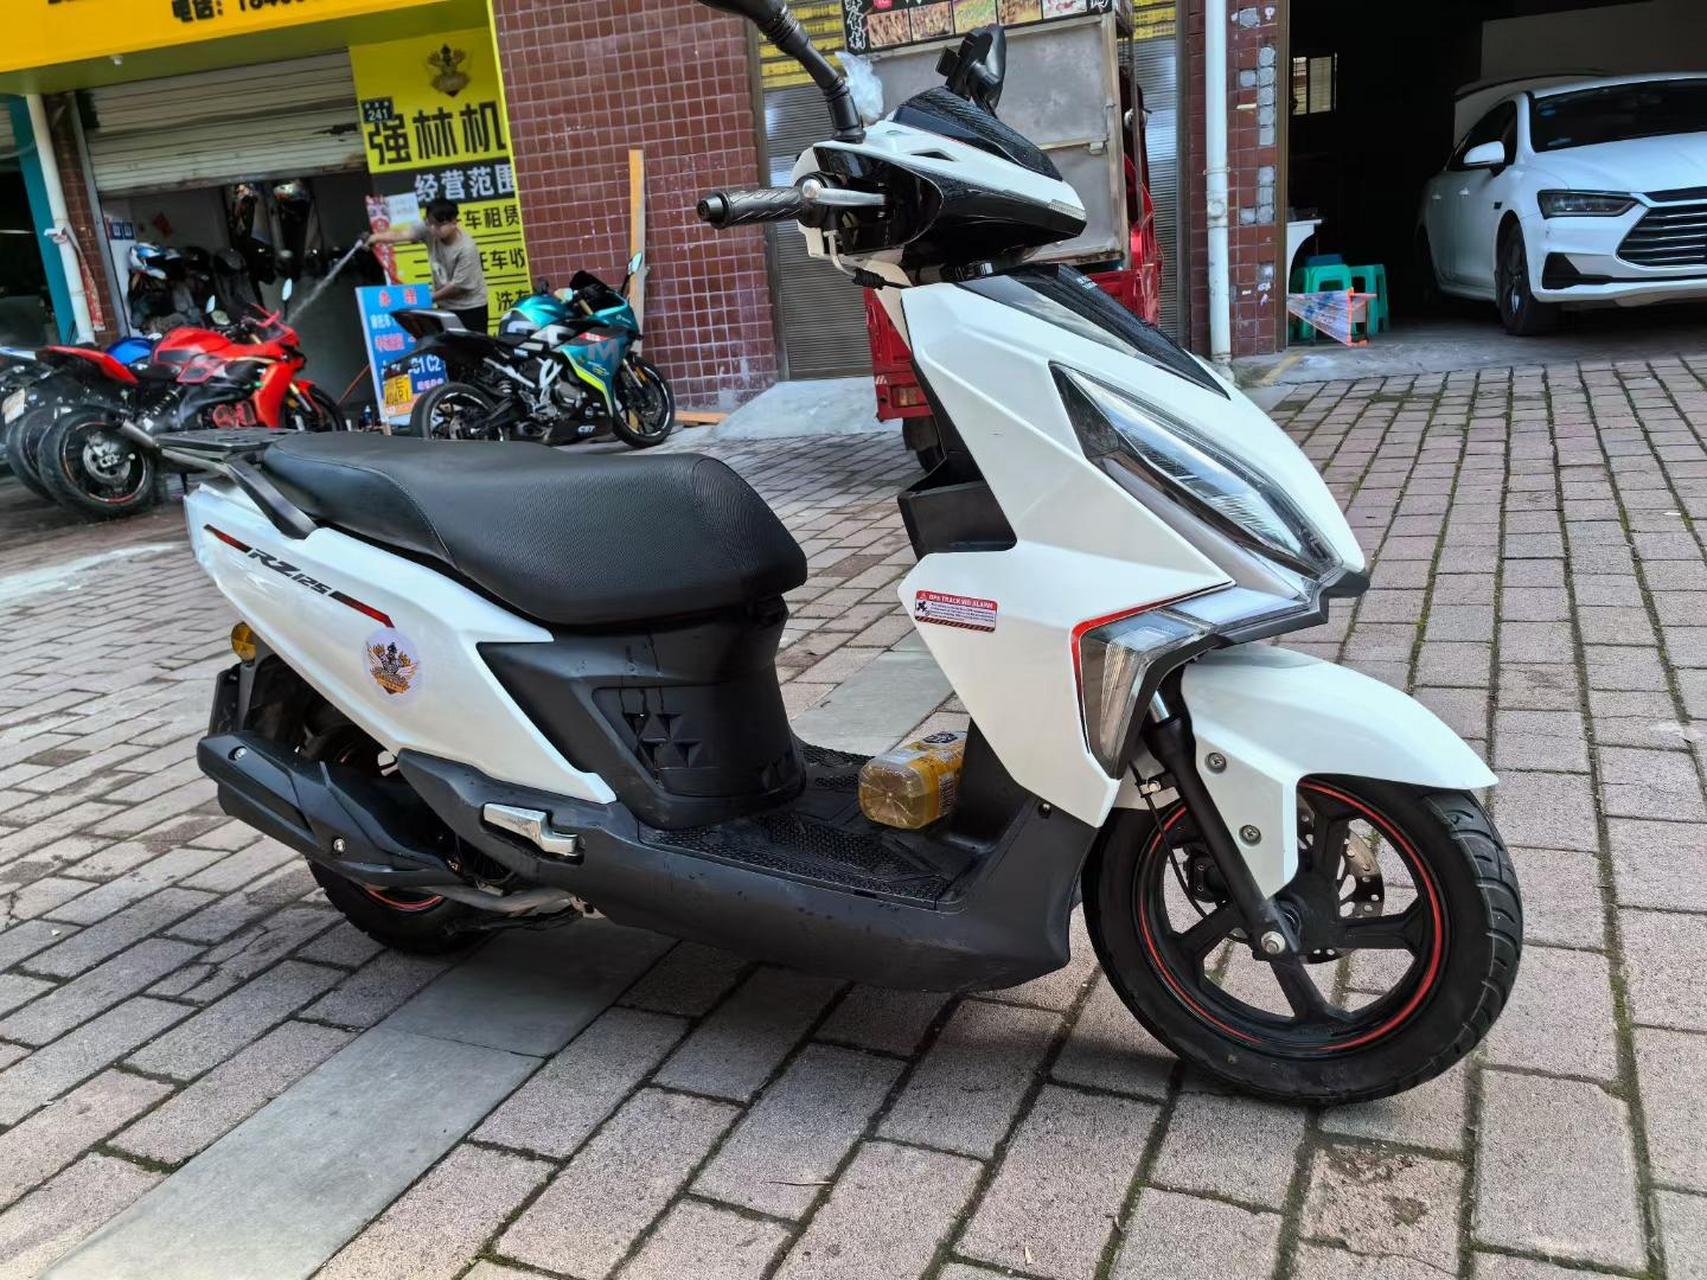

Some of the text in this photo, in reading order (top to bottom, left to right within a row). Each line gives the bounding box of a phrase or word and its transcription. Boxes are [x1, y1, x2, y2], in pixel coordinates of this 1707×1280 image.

[368, 108, 389, 121] 241
[368, 101, 506, 165] 强林机
[414, 164, 515, 202] 经营范围
[457, 205, 519, 229] 车租赁
[972, 599, 994, 609] ALARM
